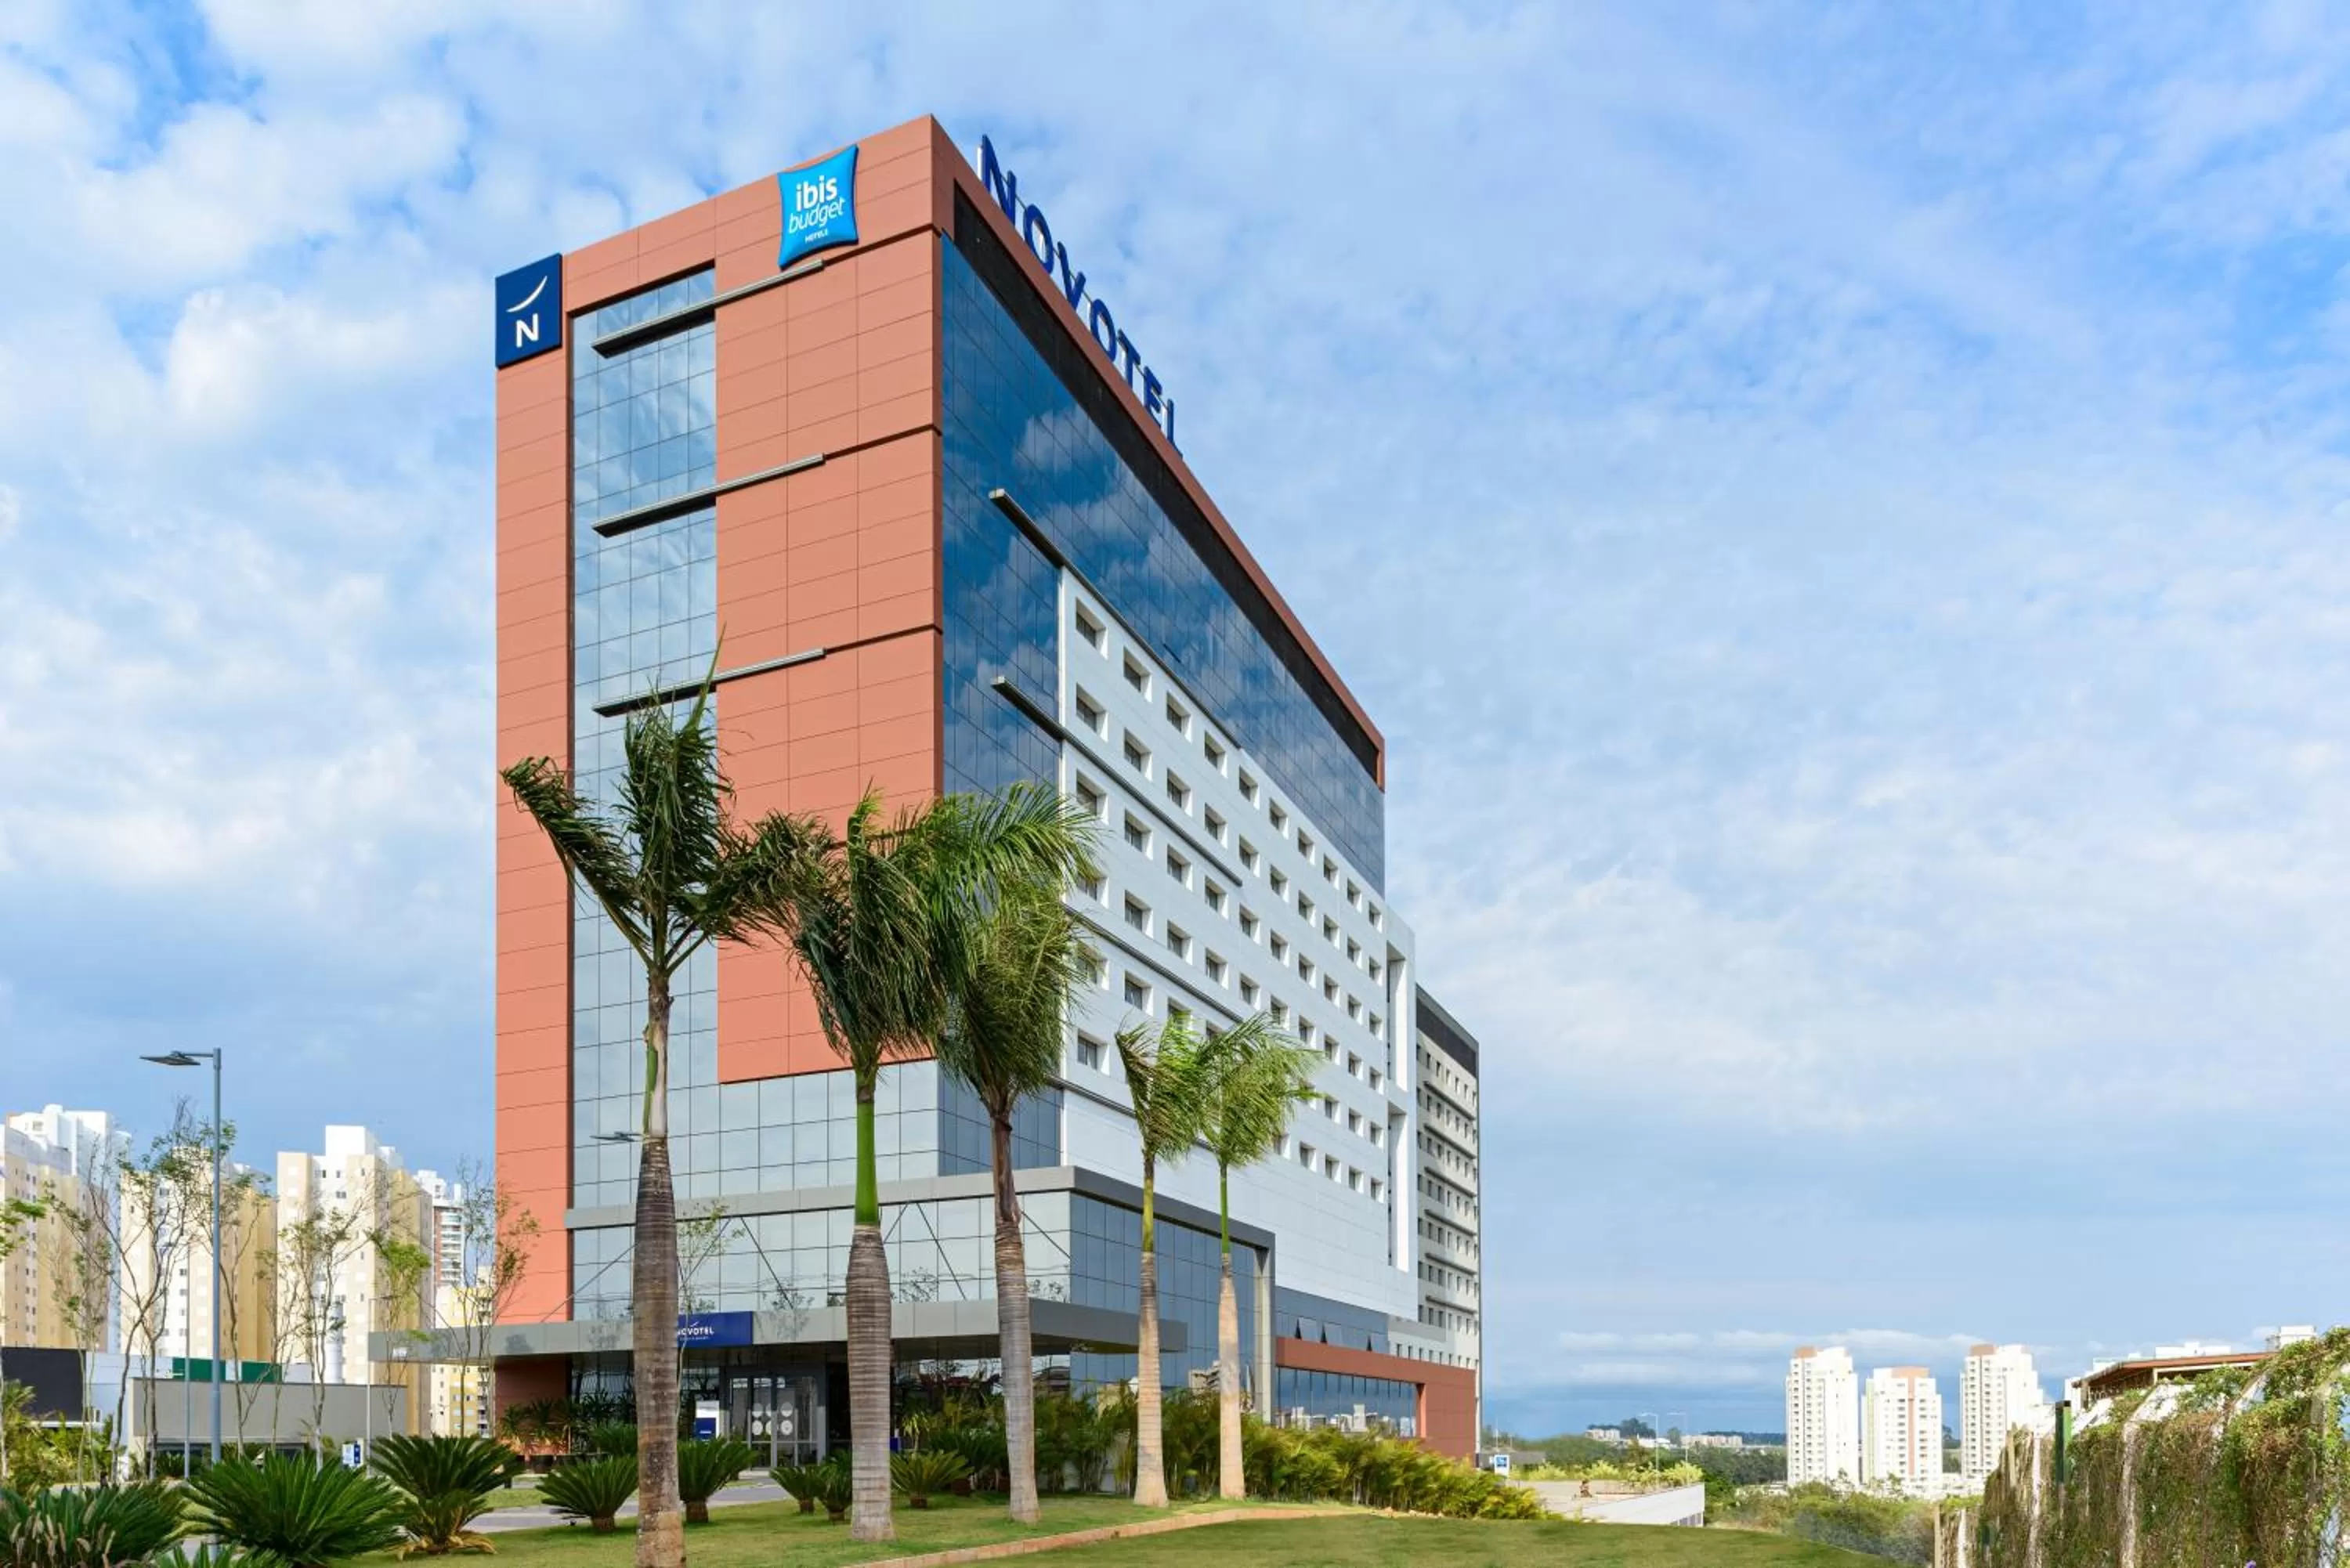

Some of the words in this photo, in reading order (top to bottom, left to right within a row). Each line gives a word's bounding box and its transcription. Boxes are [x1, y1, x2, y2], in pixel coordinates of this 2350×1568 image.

[796, 175, 838, 211] ibis
[789, 197, 845, 233] budget
[982, 134, 1183, 459] NOVOTEL
[515, 313, 539, 348] N
